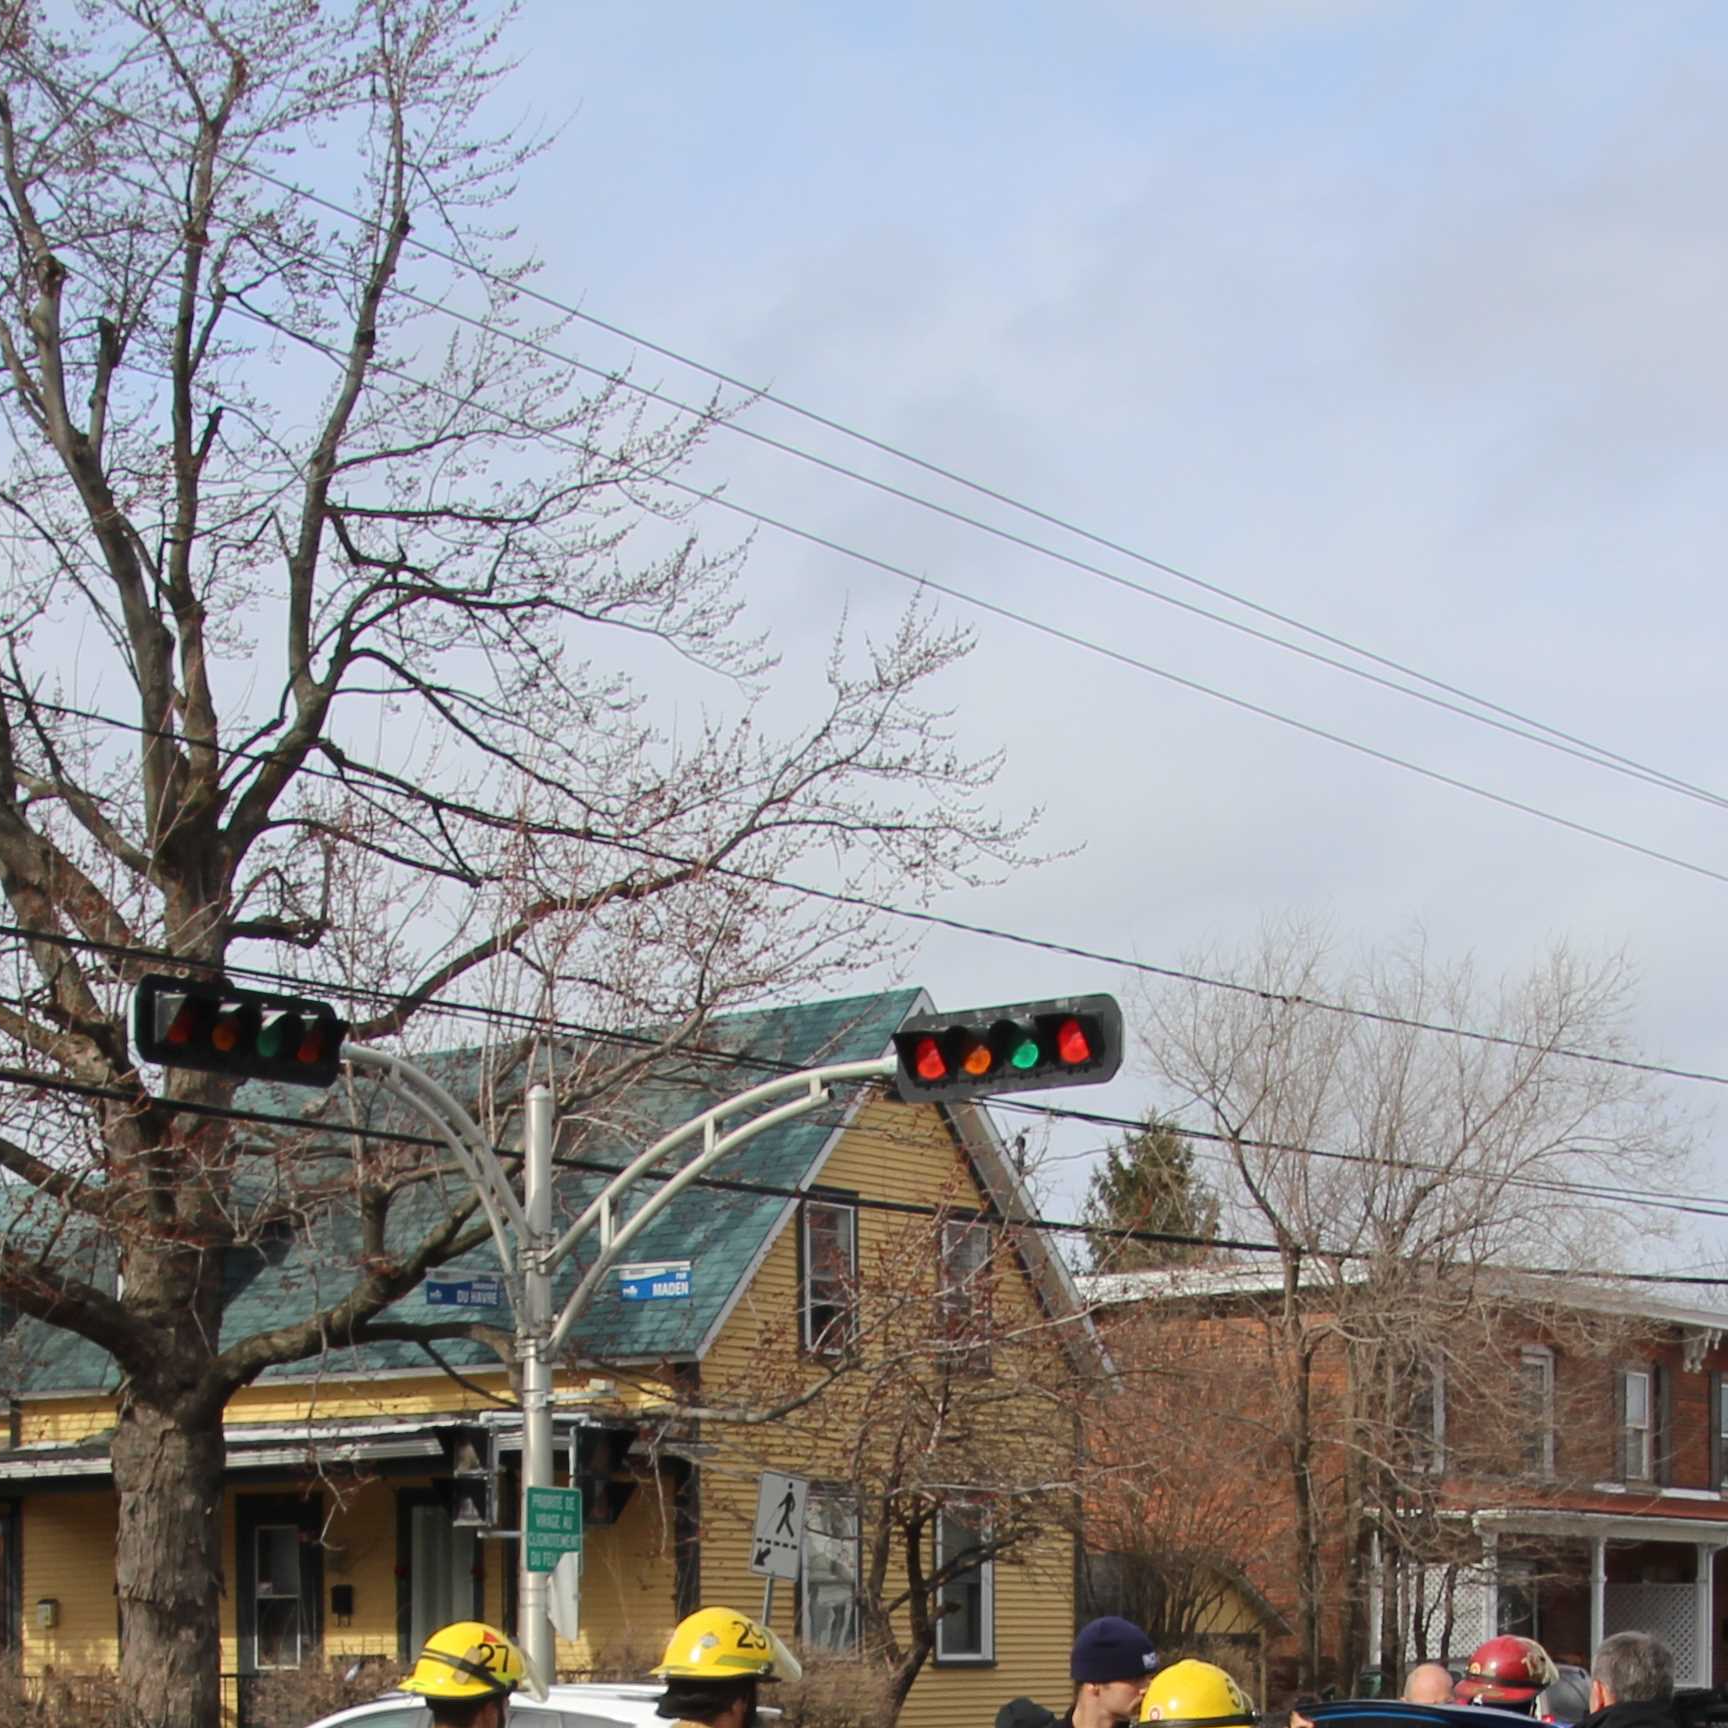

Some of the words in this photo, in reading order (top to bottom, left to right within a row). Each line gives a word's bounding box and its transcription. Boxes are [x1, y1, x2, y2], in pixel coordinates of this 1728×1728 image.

[456, 1289, 469, 1303] DU
[652, 1281, 689, 1297] MADEN
[530, 1551, 541, 1567] DU
[478, 1643, 509, 1673] 27
